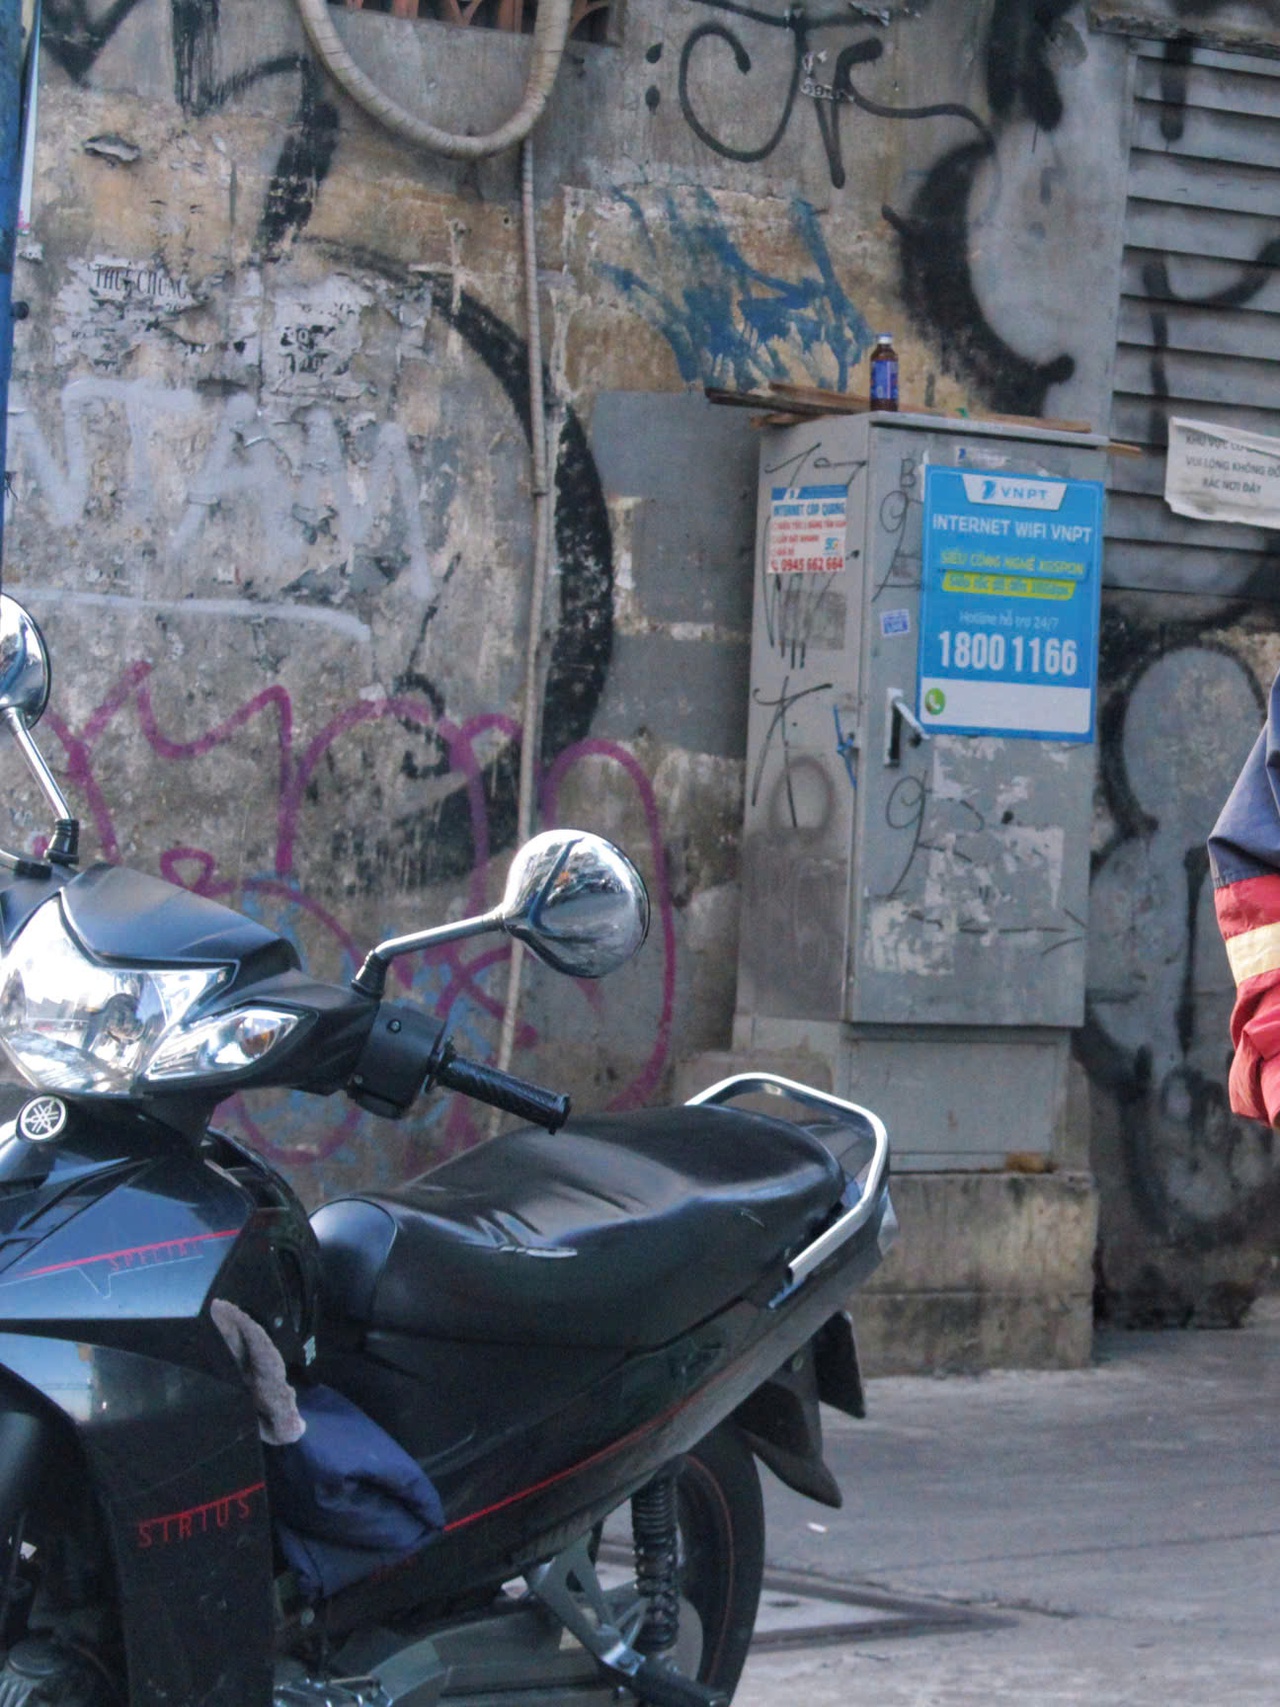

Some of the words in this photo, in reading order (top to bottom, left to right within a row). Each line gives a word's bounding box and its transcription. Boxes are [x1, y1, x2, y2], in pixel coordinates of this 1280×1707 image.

[1232, 460, 1265, 477] KHÔNG
[1002, 486, 1049, 500] VNPT
[933, 513, 1011, 536] INTERNET
[1015, 521, 1047, 538] WIFI
[1051, 524, 1092, 544] VNPT
[781, 558, 804, 572] 0945
[807, 557, 824, 571] 662
[958, 609, 997, 626] Hotline
[1034, 615, 1060, 630] 24/7
[938, 630, 1006, 671] 1800
[1011, 635, 1078, 676] 1166
[138, 1499, 251, 1549] SIRIUS
